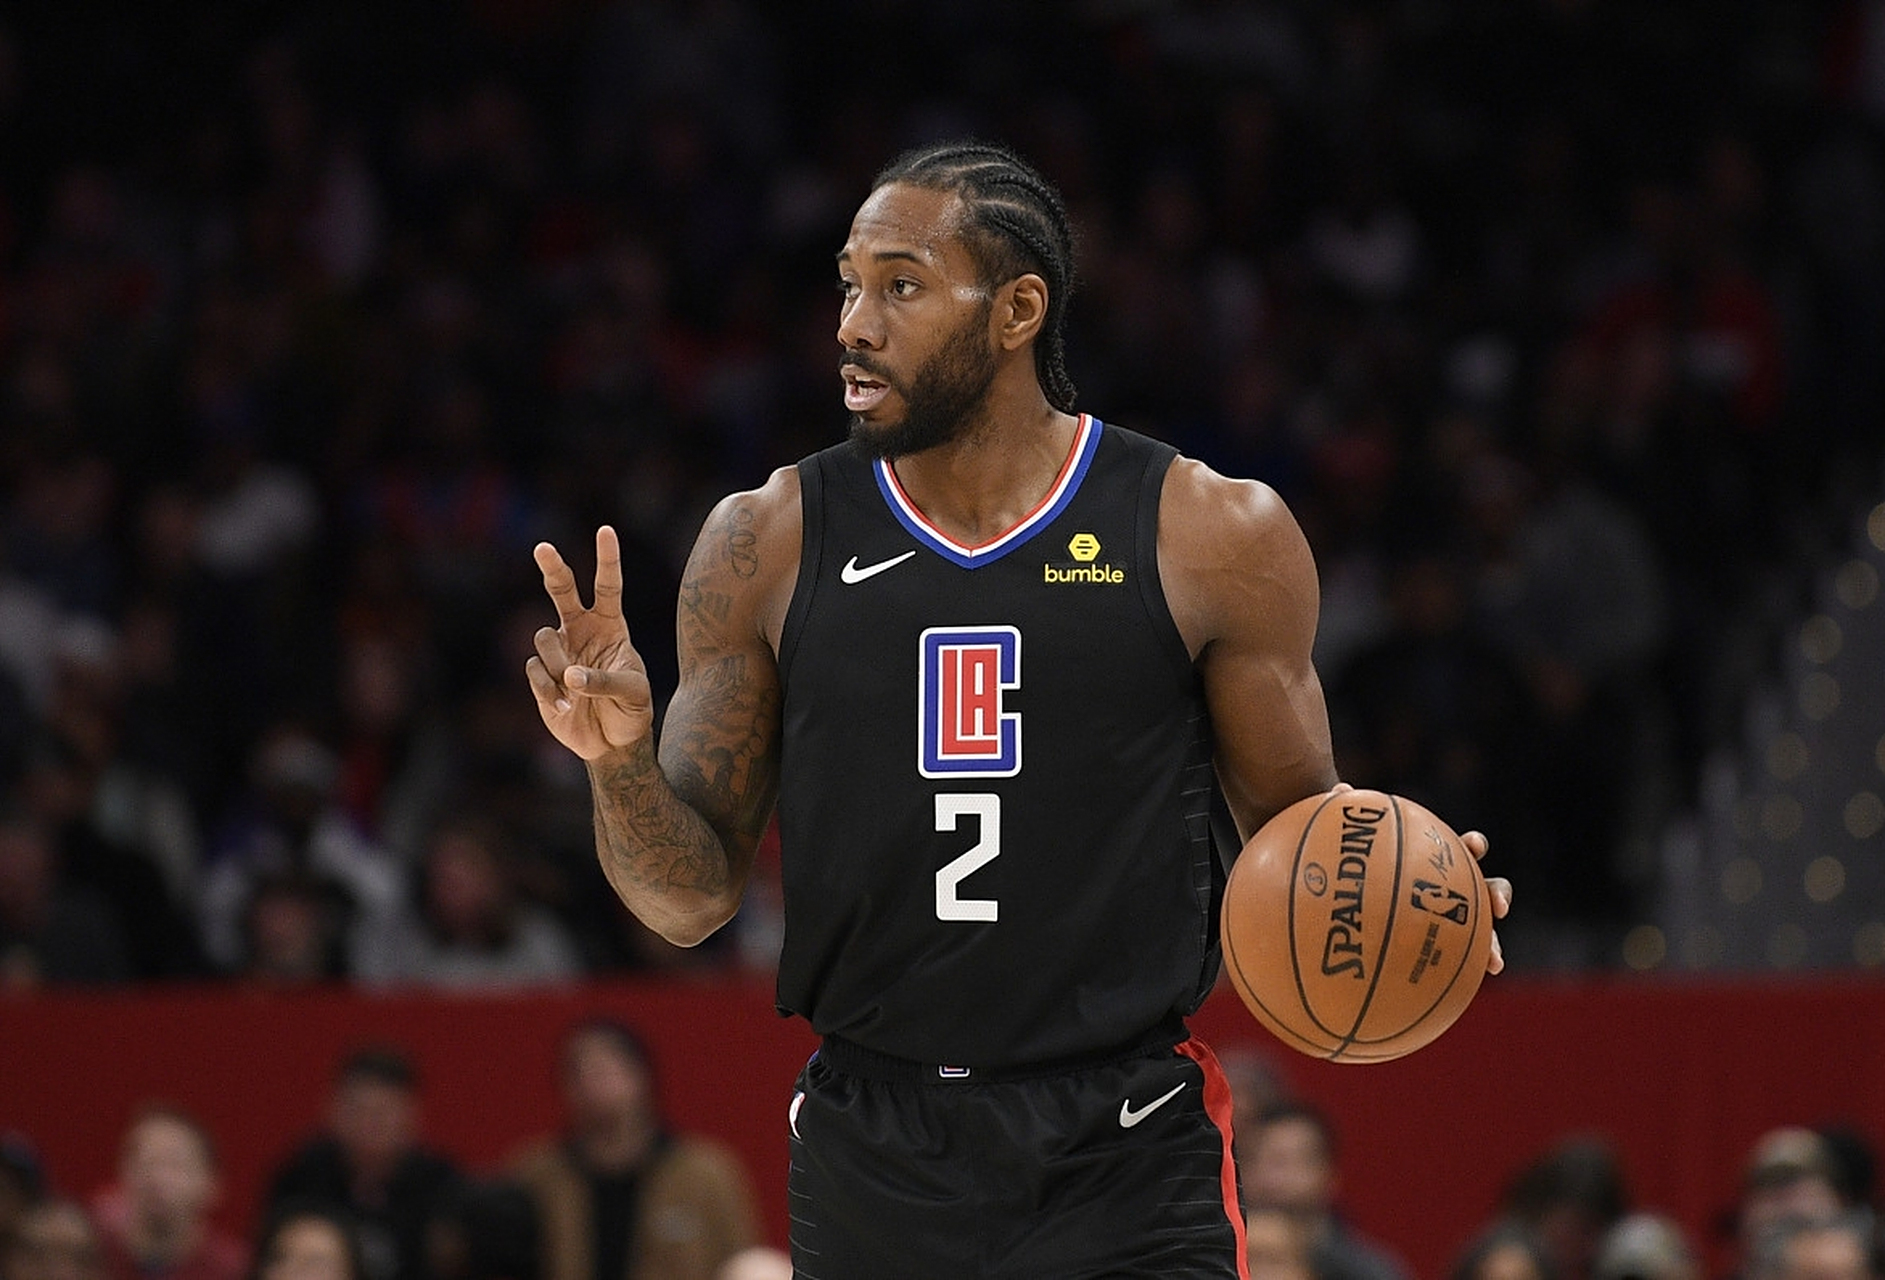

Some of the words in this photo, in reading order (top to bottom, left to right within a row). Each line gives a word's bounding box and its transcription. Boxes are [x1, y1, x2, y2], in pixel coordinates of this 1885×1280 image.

[1043, 563, 1125, 584] bumble
[934, 792, 1001, 922] 2
[1321, 805, 1387, 980] SPALDING
